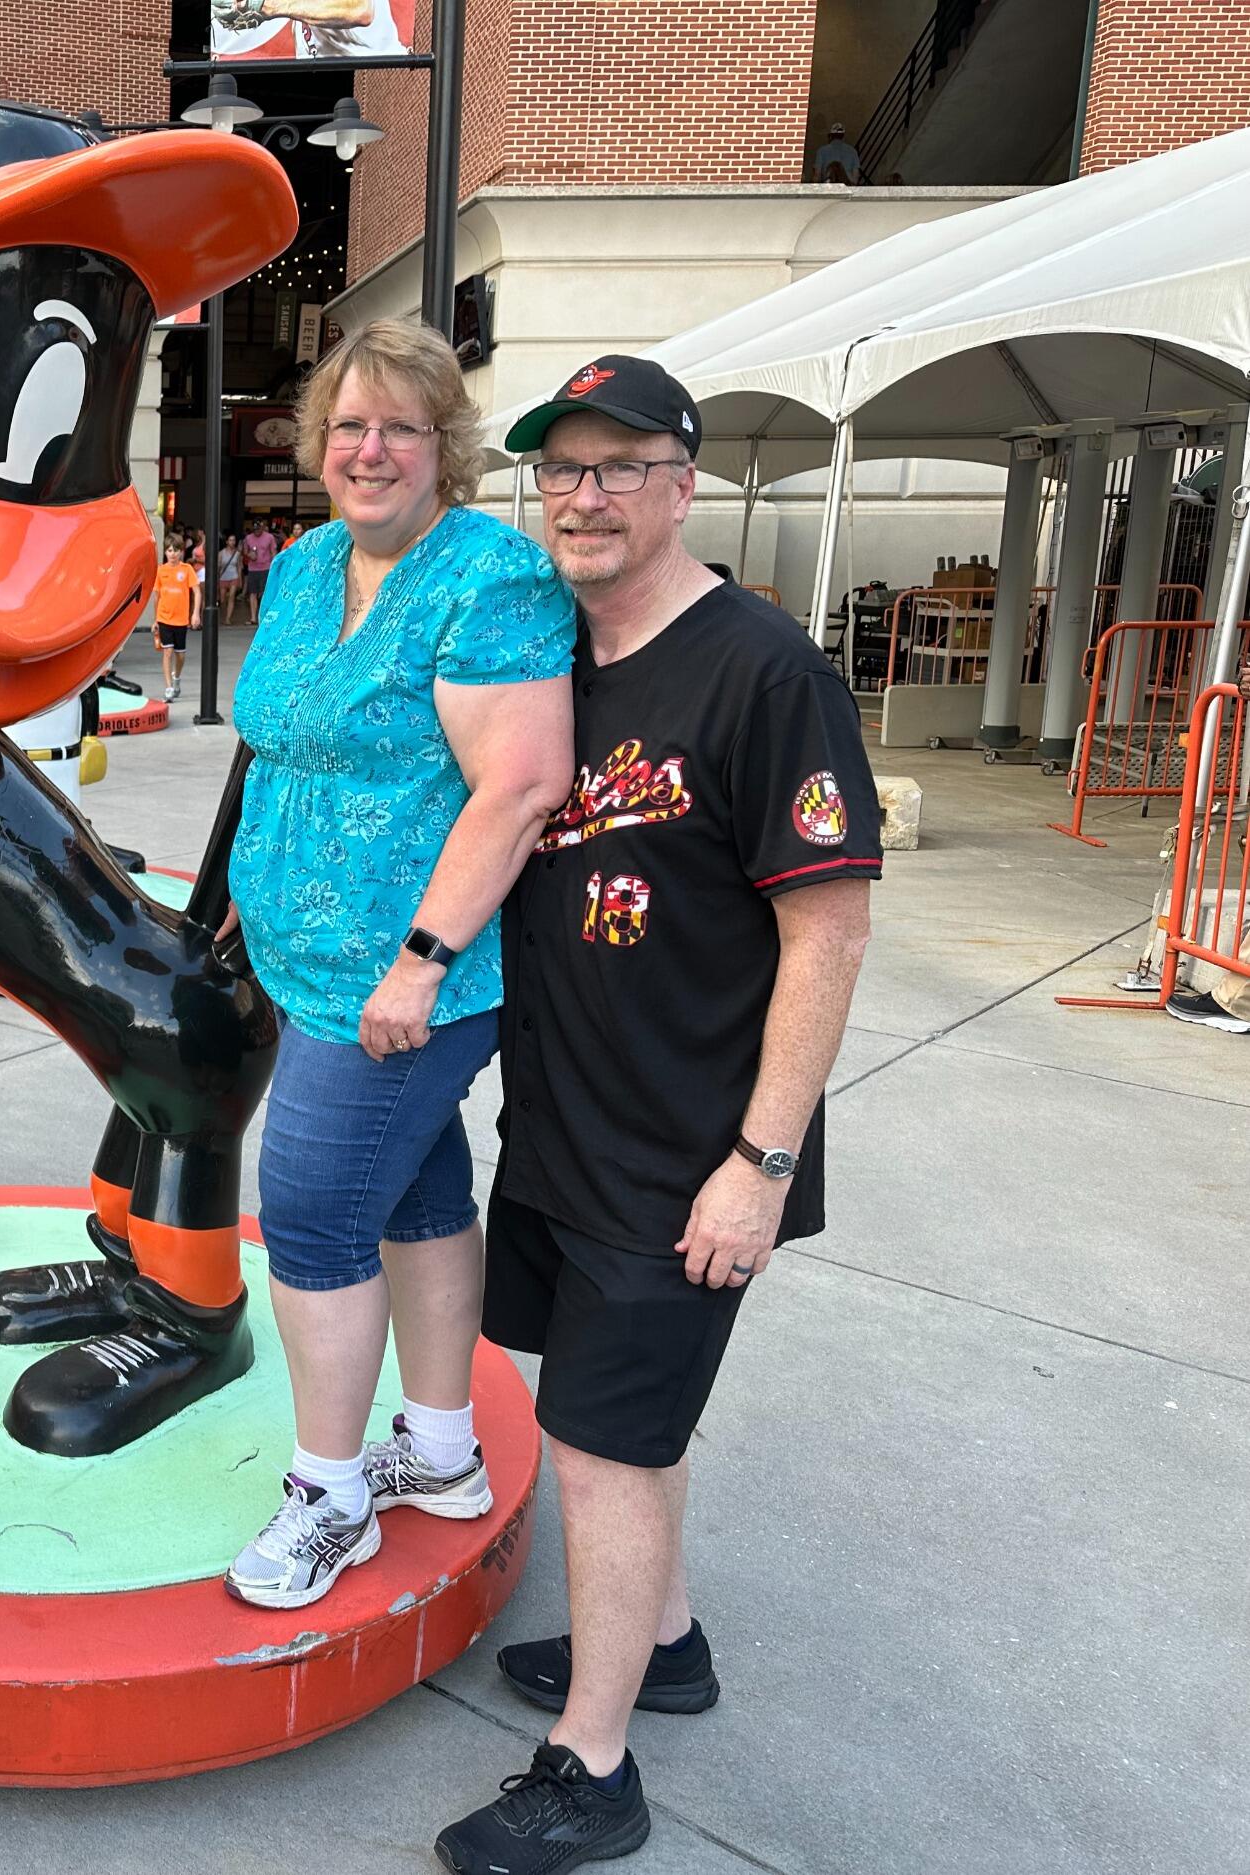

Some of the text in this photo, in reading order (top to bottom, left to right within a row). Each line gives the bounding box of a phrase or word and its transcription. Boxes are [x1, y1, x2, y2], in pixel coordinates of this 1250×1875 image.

[279, 304, 290, 343] SAUSAGE
[301, 317, 315, 352] BEER
[582, 870, 652, 946] 18
